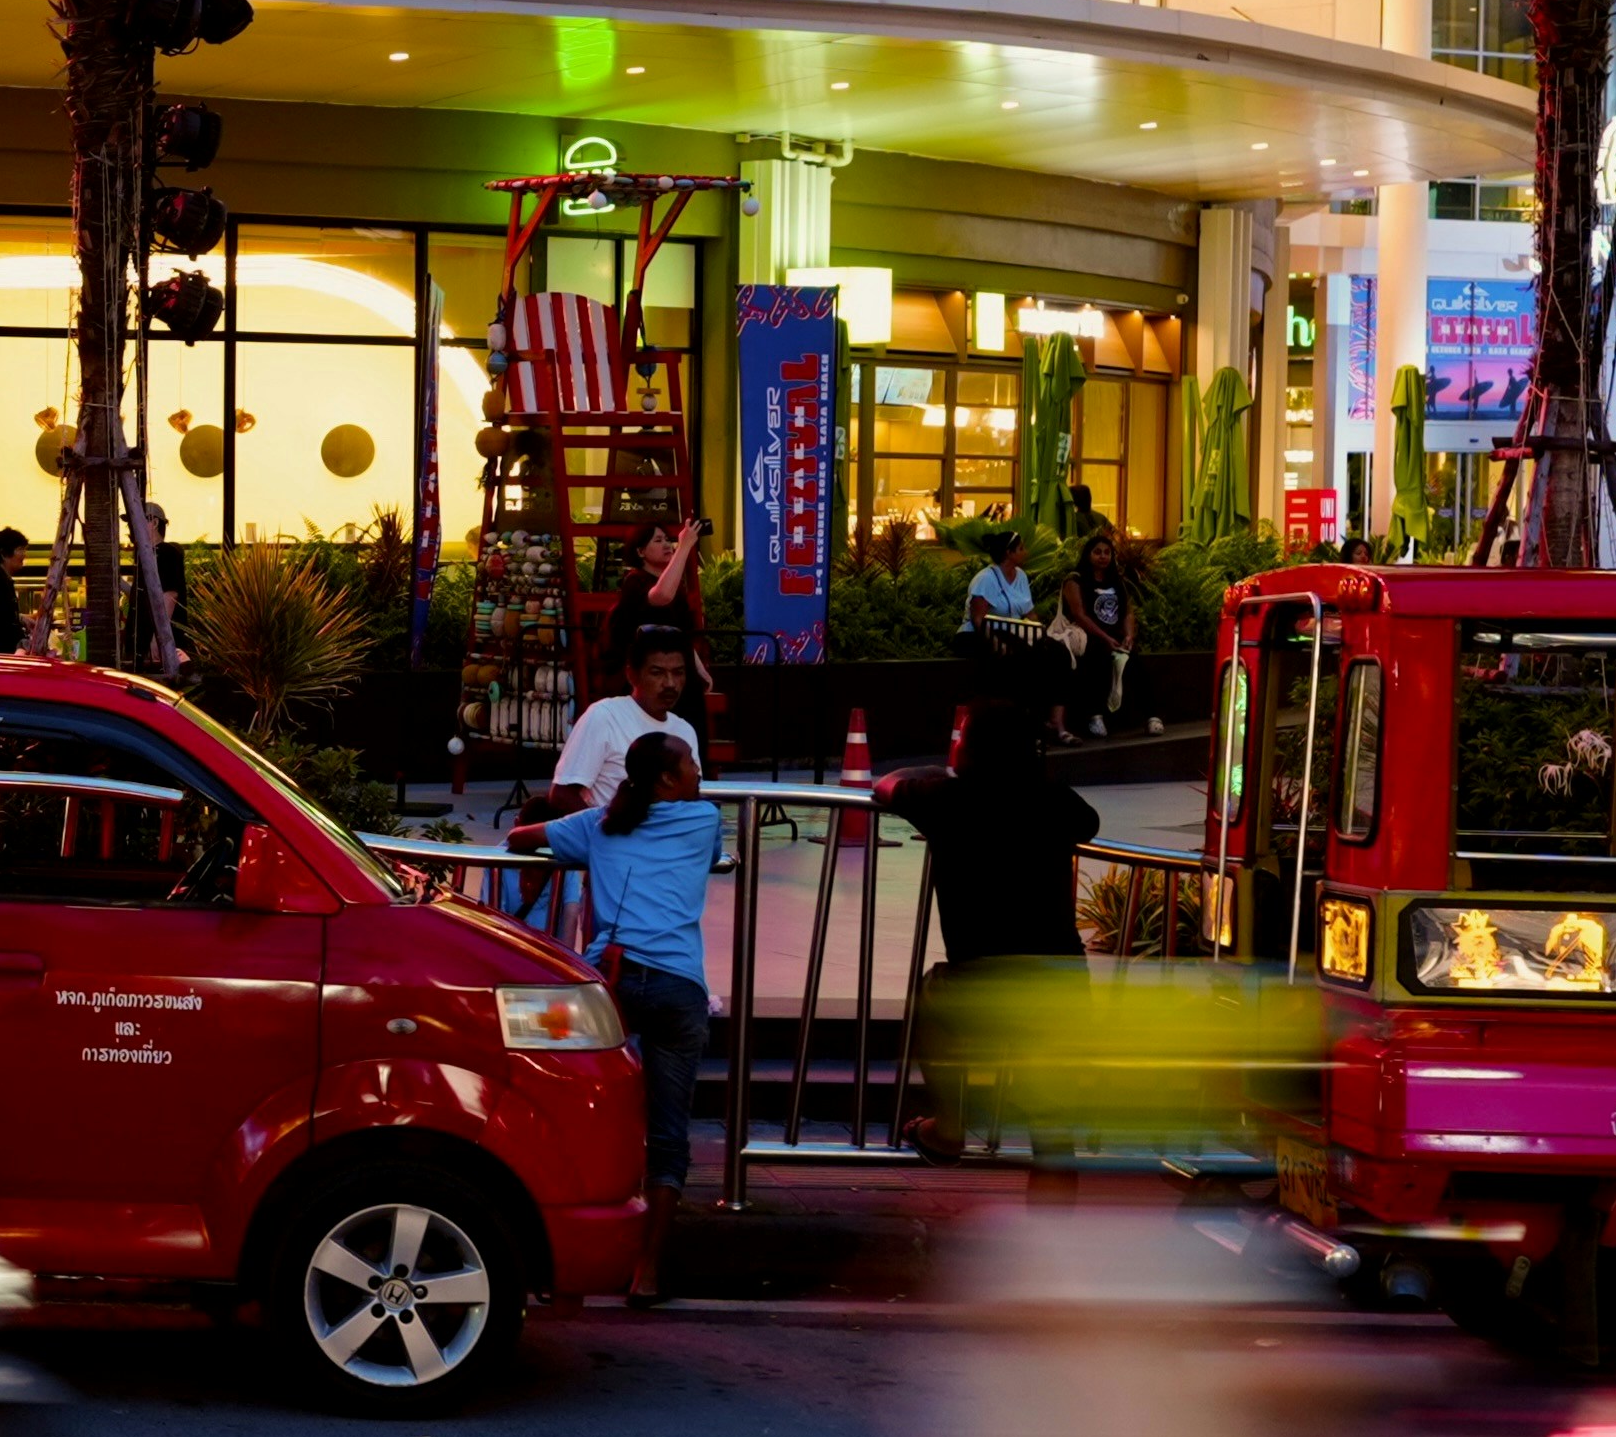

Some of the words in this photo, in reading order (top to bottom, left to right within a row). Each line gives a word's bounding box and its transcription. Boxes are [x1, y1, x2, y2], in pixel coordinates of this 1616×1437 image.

[1426, 312, 1536, 347] ESTIVAL
[764, 387, 782, 563] QUIKSILVER
[779, 353, 819, 596] FESTIVAL
[114, 1021, 141, 1036] และ
[81, 1038, 173, 1065] การท่องเที่ยว
